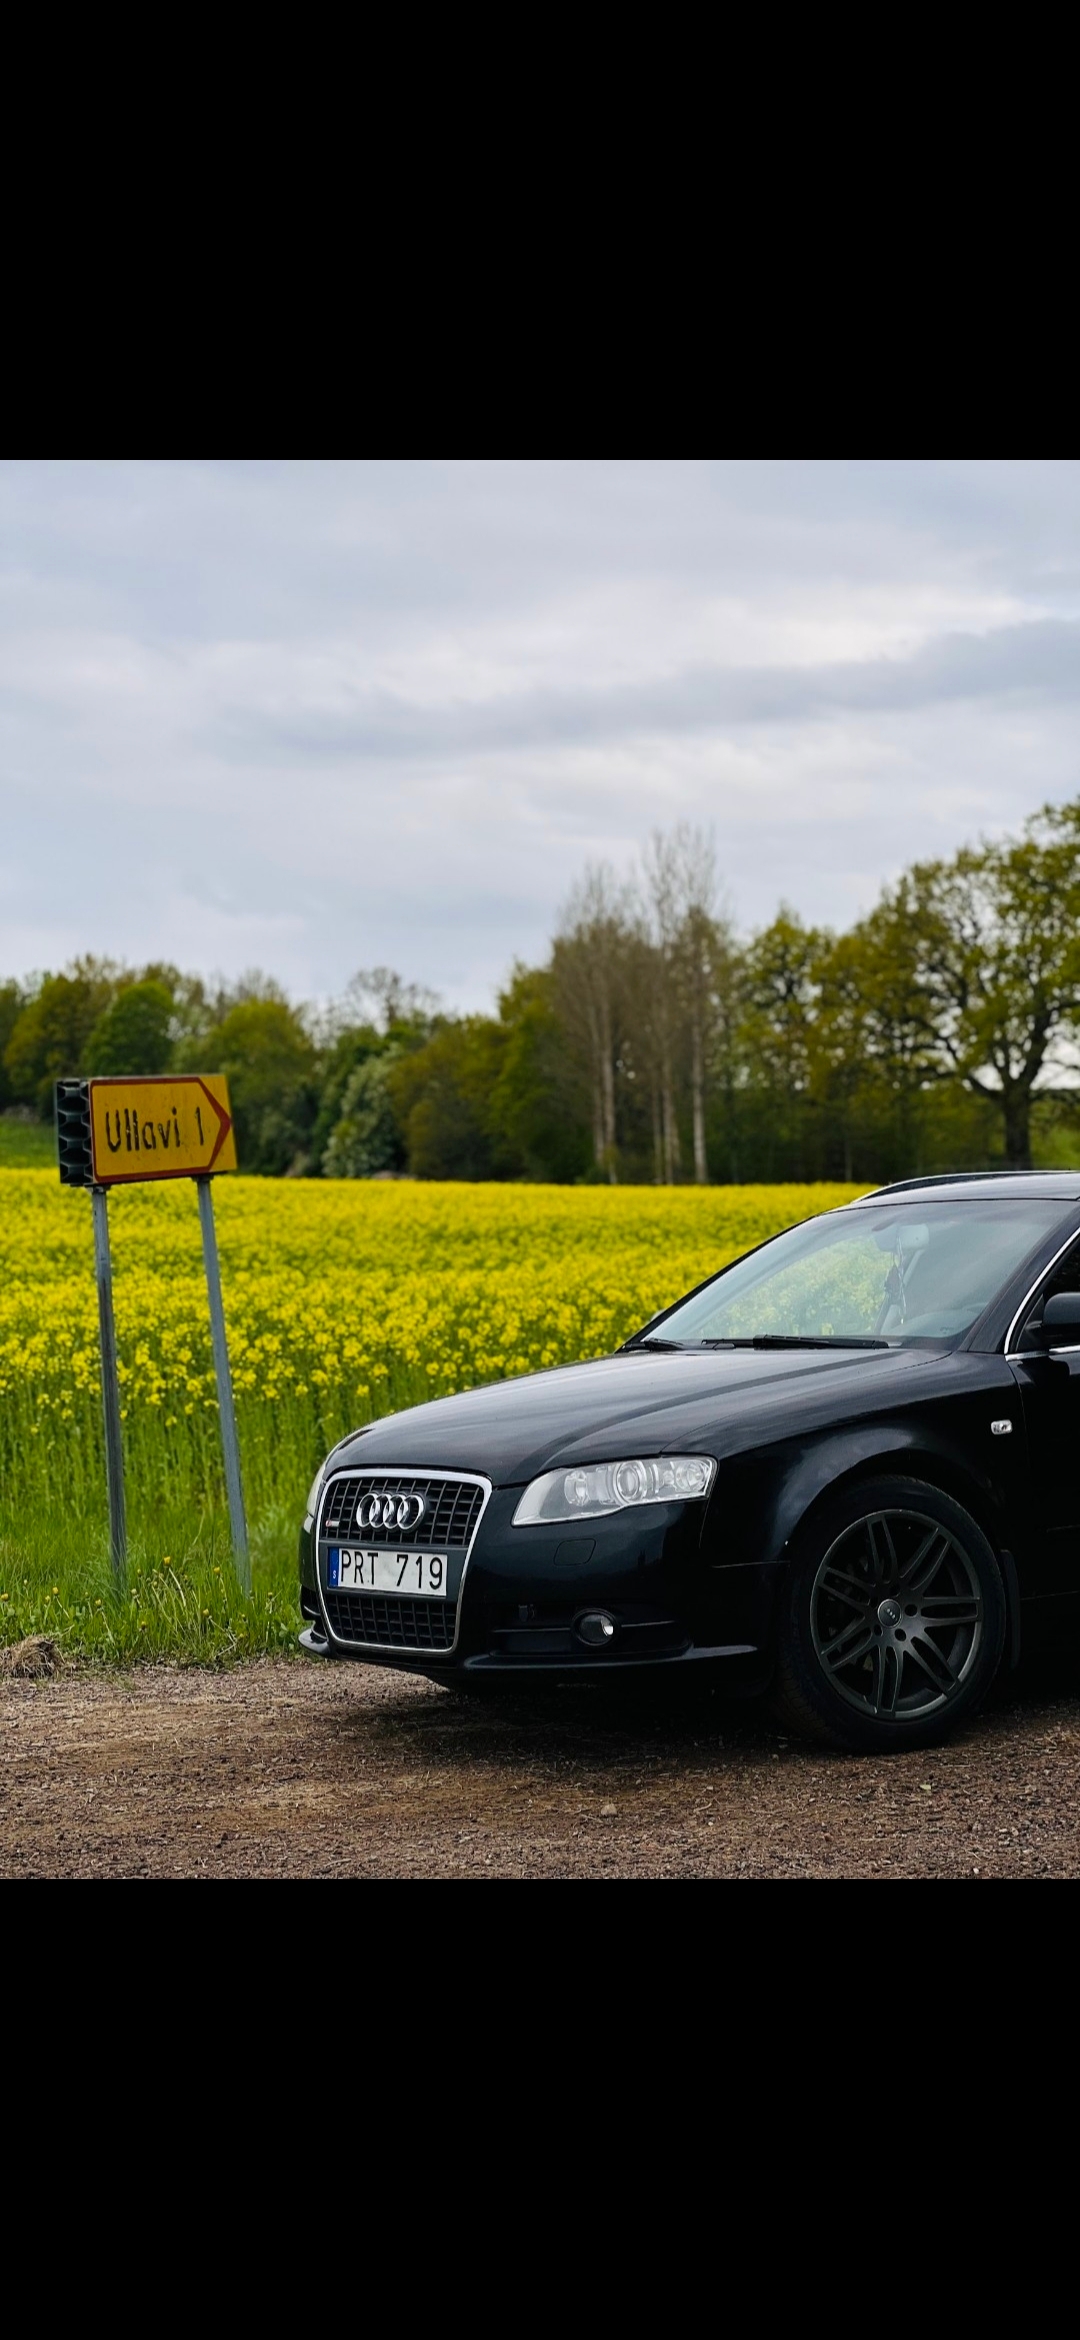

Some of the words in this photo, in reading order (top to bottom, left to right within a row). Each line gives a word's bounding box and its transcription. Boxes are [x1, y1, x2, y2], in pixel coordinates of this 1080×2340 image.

[105, 1106, 181, 1152] Ullavi
[195, 1106, 204, 1146] 1
[332, 1569, 337, 1579] S
[340, 1550, 379, 1585] PRT
[396, 1554, 443, 1590] 719
